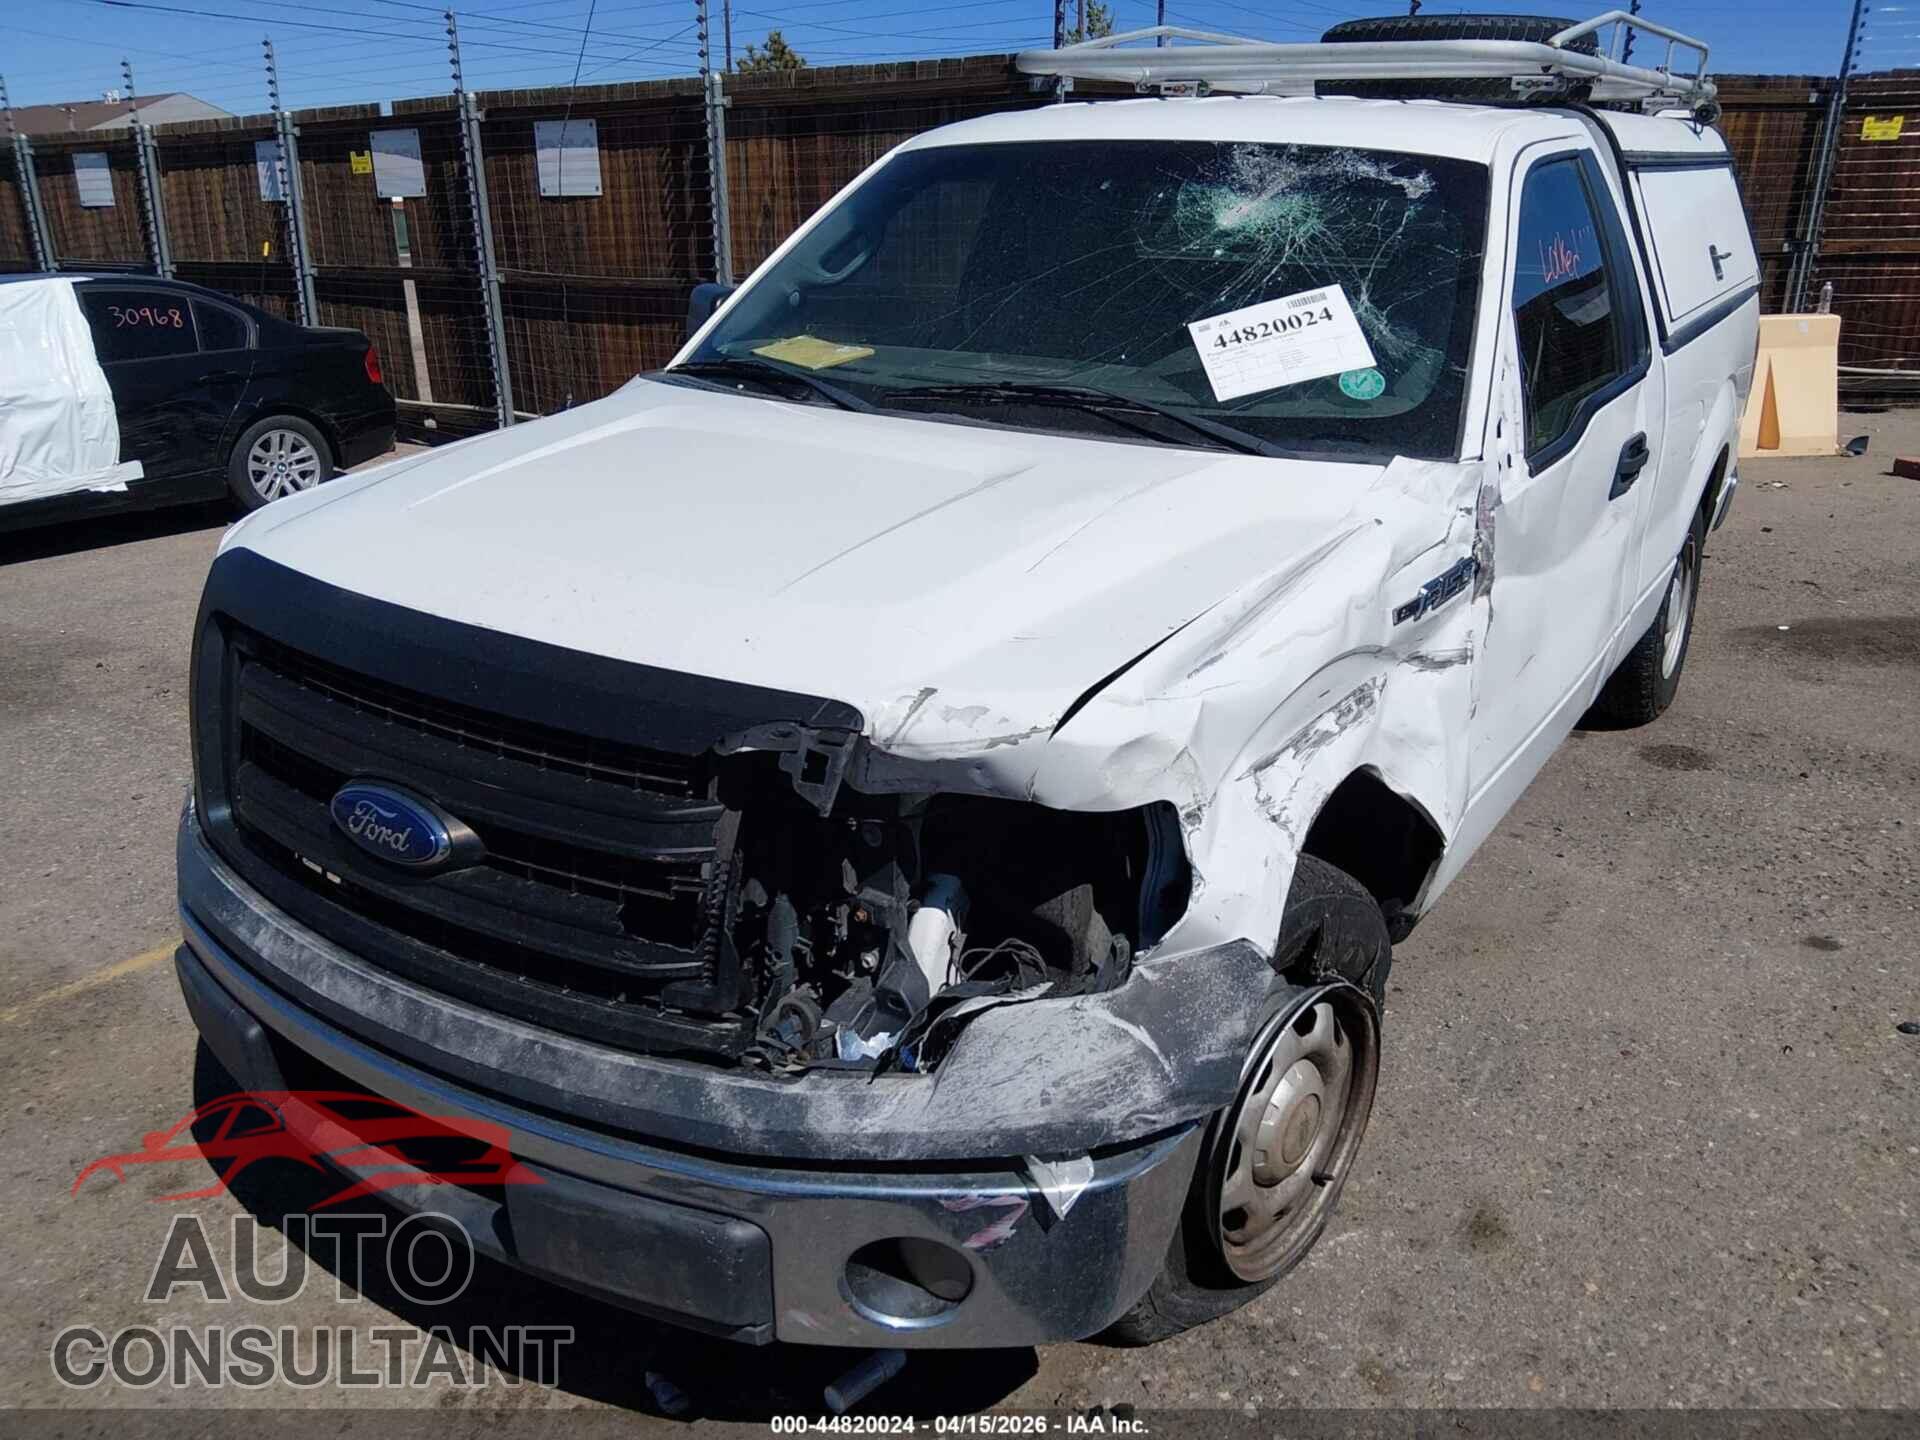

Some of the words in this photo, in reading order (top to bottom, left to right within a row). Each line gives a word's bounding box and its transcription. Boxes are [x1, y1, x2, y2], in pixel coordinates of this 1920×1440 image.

[107, 305, 184, 329] 30968
[1213, 306, 1334, 349] 44820024
[347, 799, 413, 851] Ford
